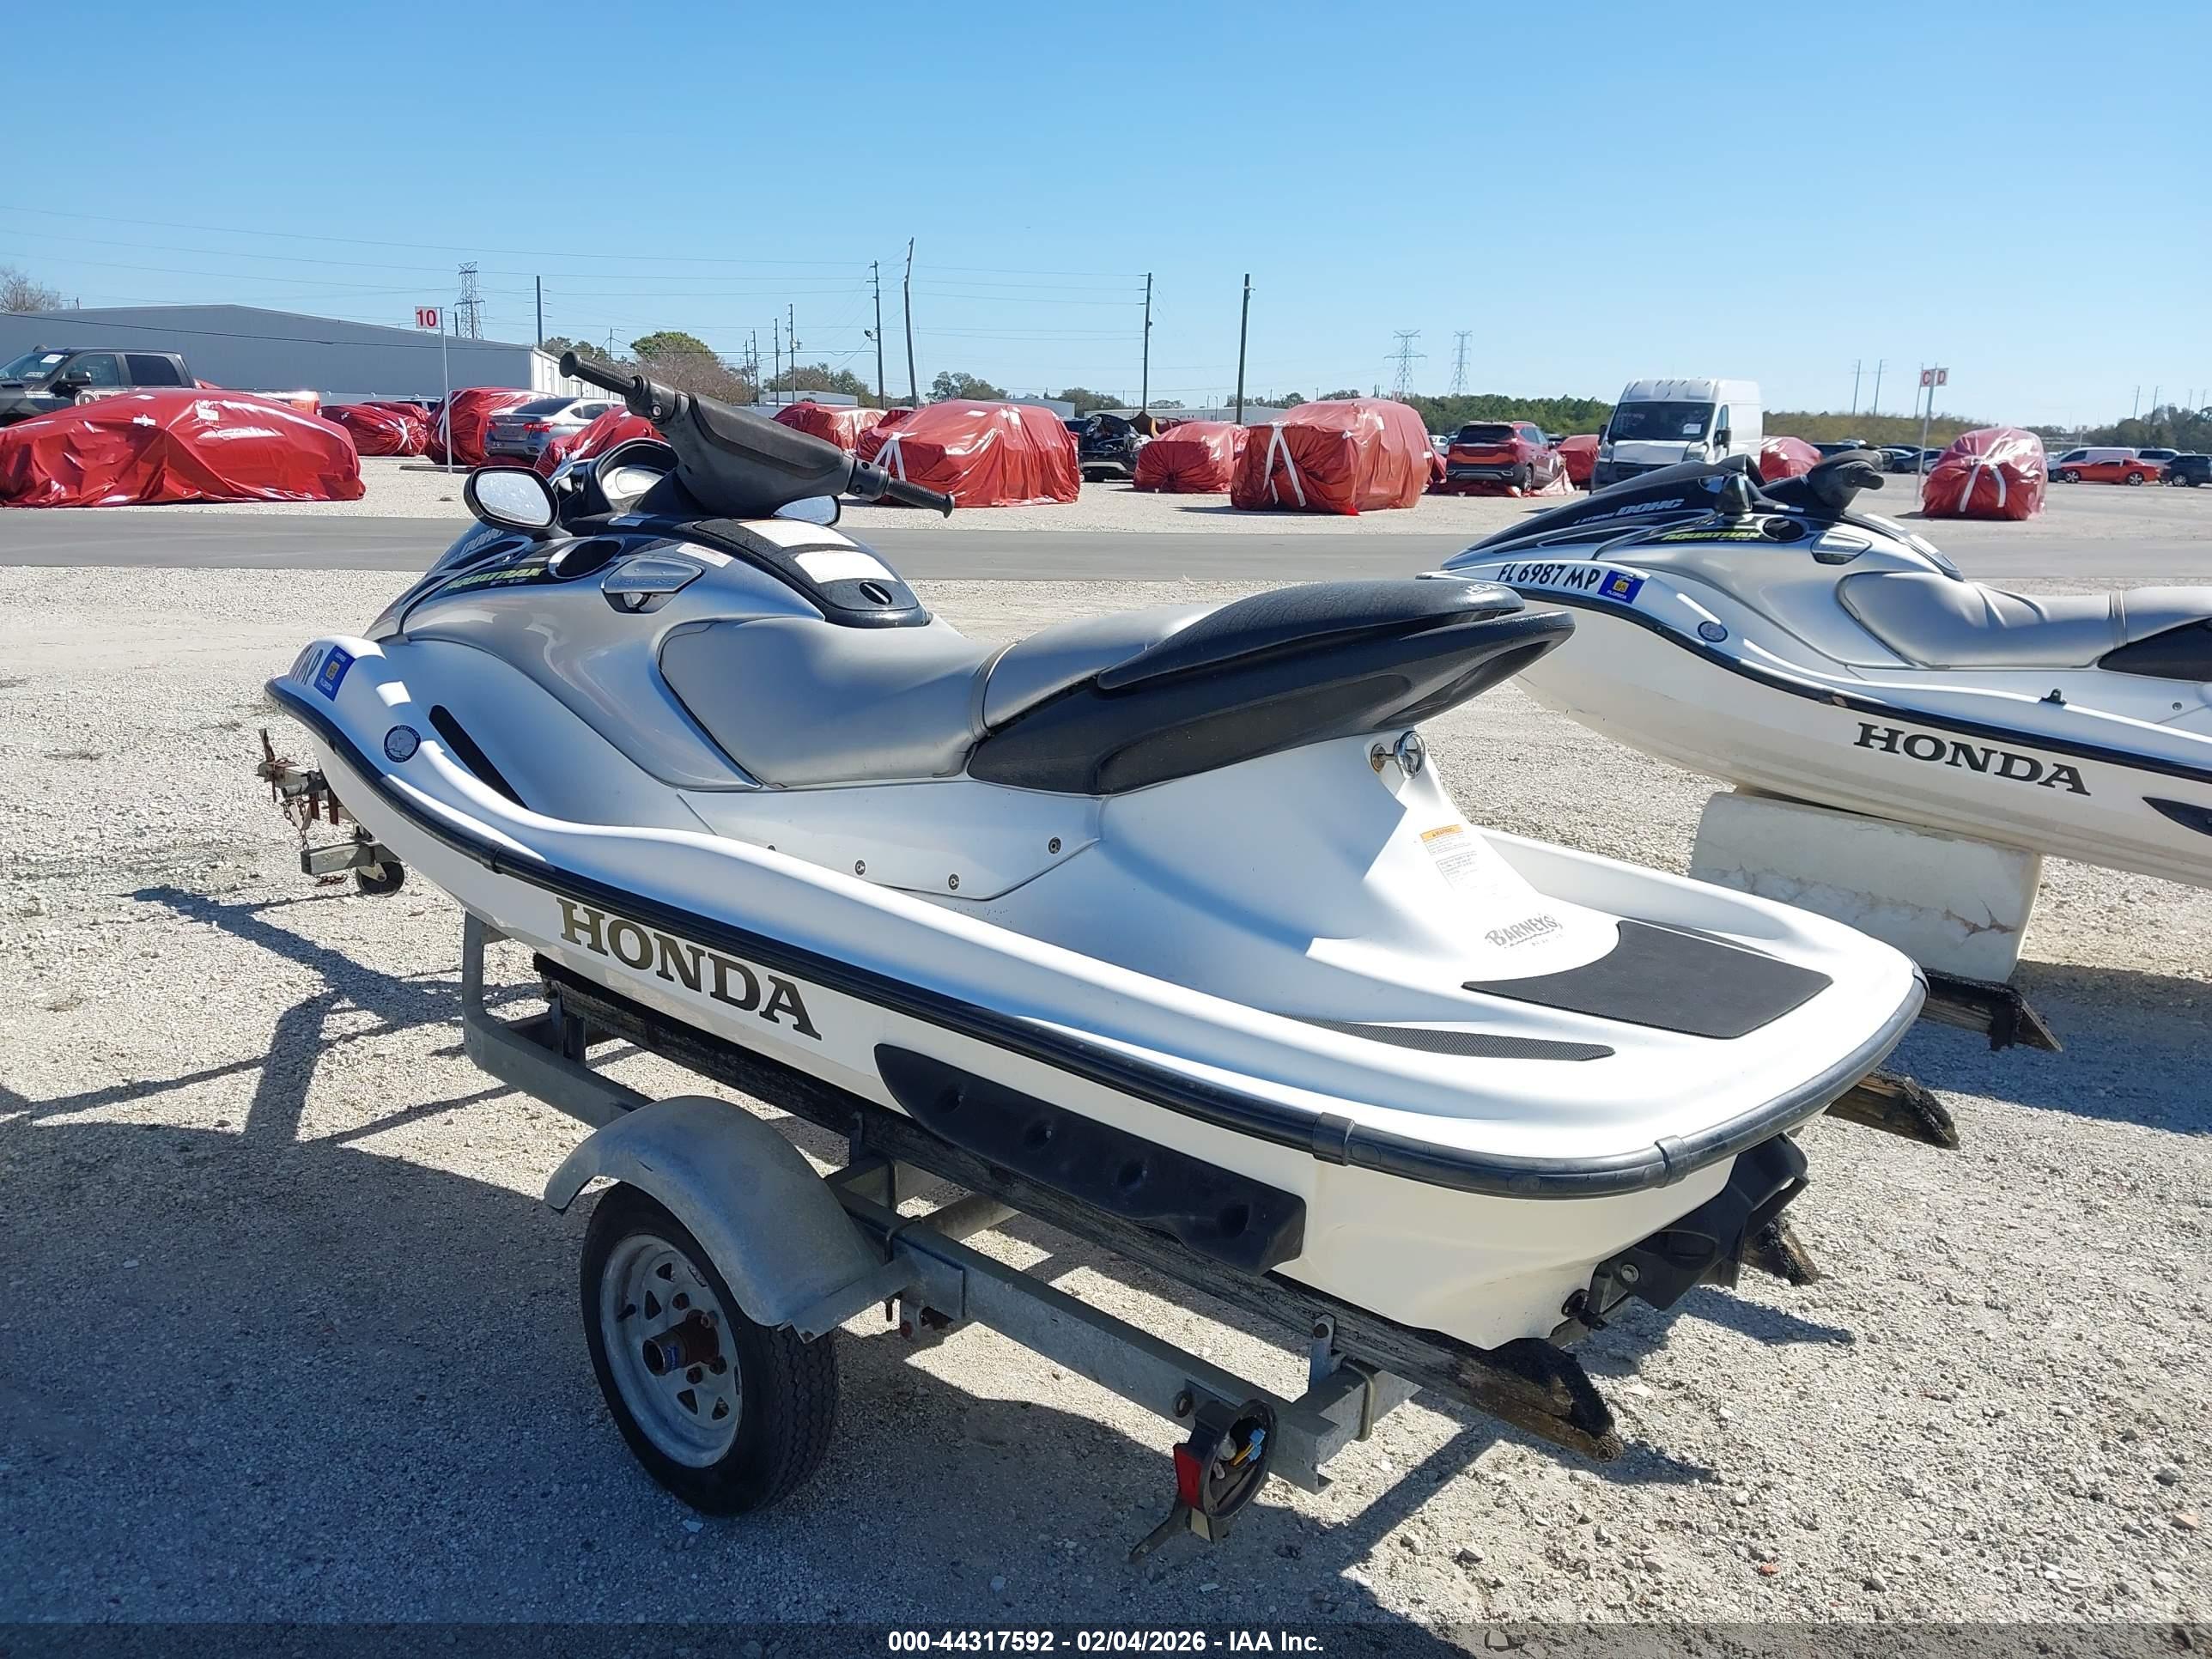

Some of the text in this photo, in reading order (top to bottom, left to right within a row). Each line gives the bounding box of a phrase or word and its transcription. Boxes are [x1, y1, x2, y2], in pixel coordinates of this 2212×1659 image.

[416, 309, 437, 326] 10
[1923, 371, 1931, 385] C
[1937, 370, 1946, 385] D
[1615, 498, 1685, 516] DOHC
[1497, 563, 1519, 582] FL
[1516, 563, 1568, 587] 6987
[1563, 565, 1601, 591] MP
[1853, 722, 2092, 797] HONDA
[556, 896, 823, 1042] HONDA
